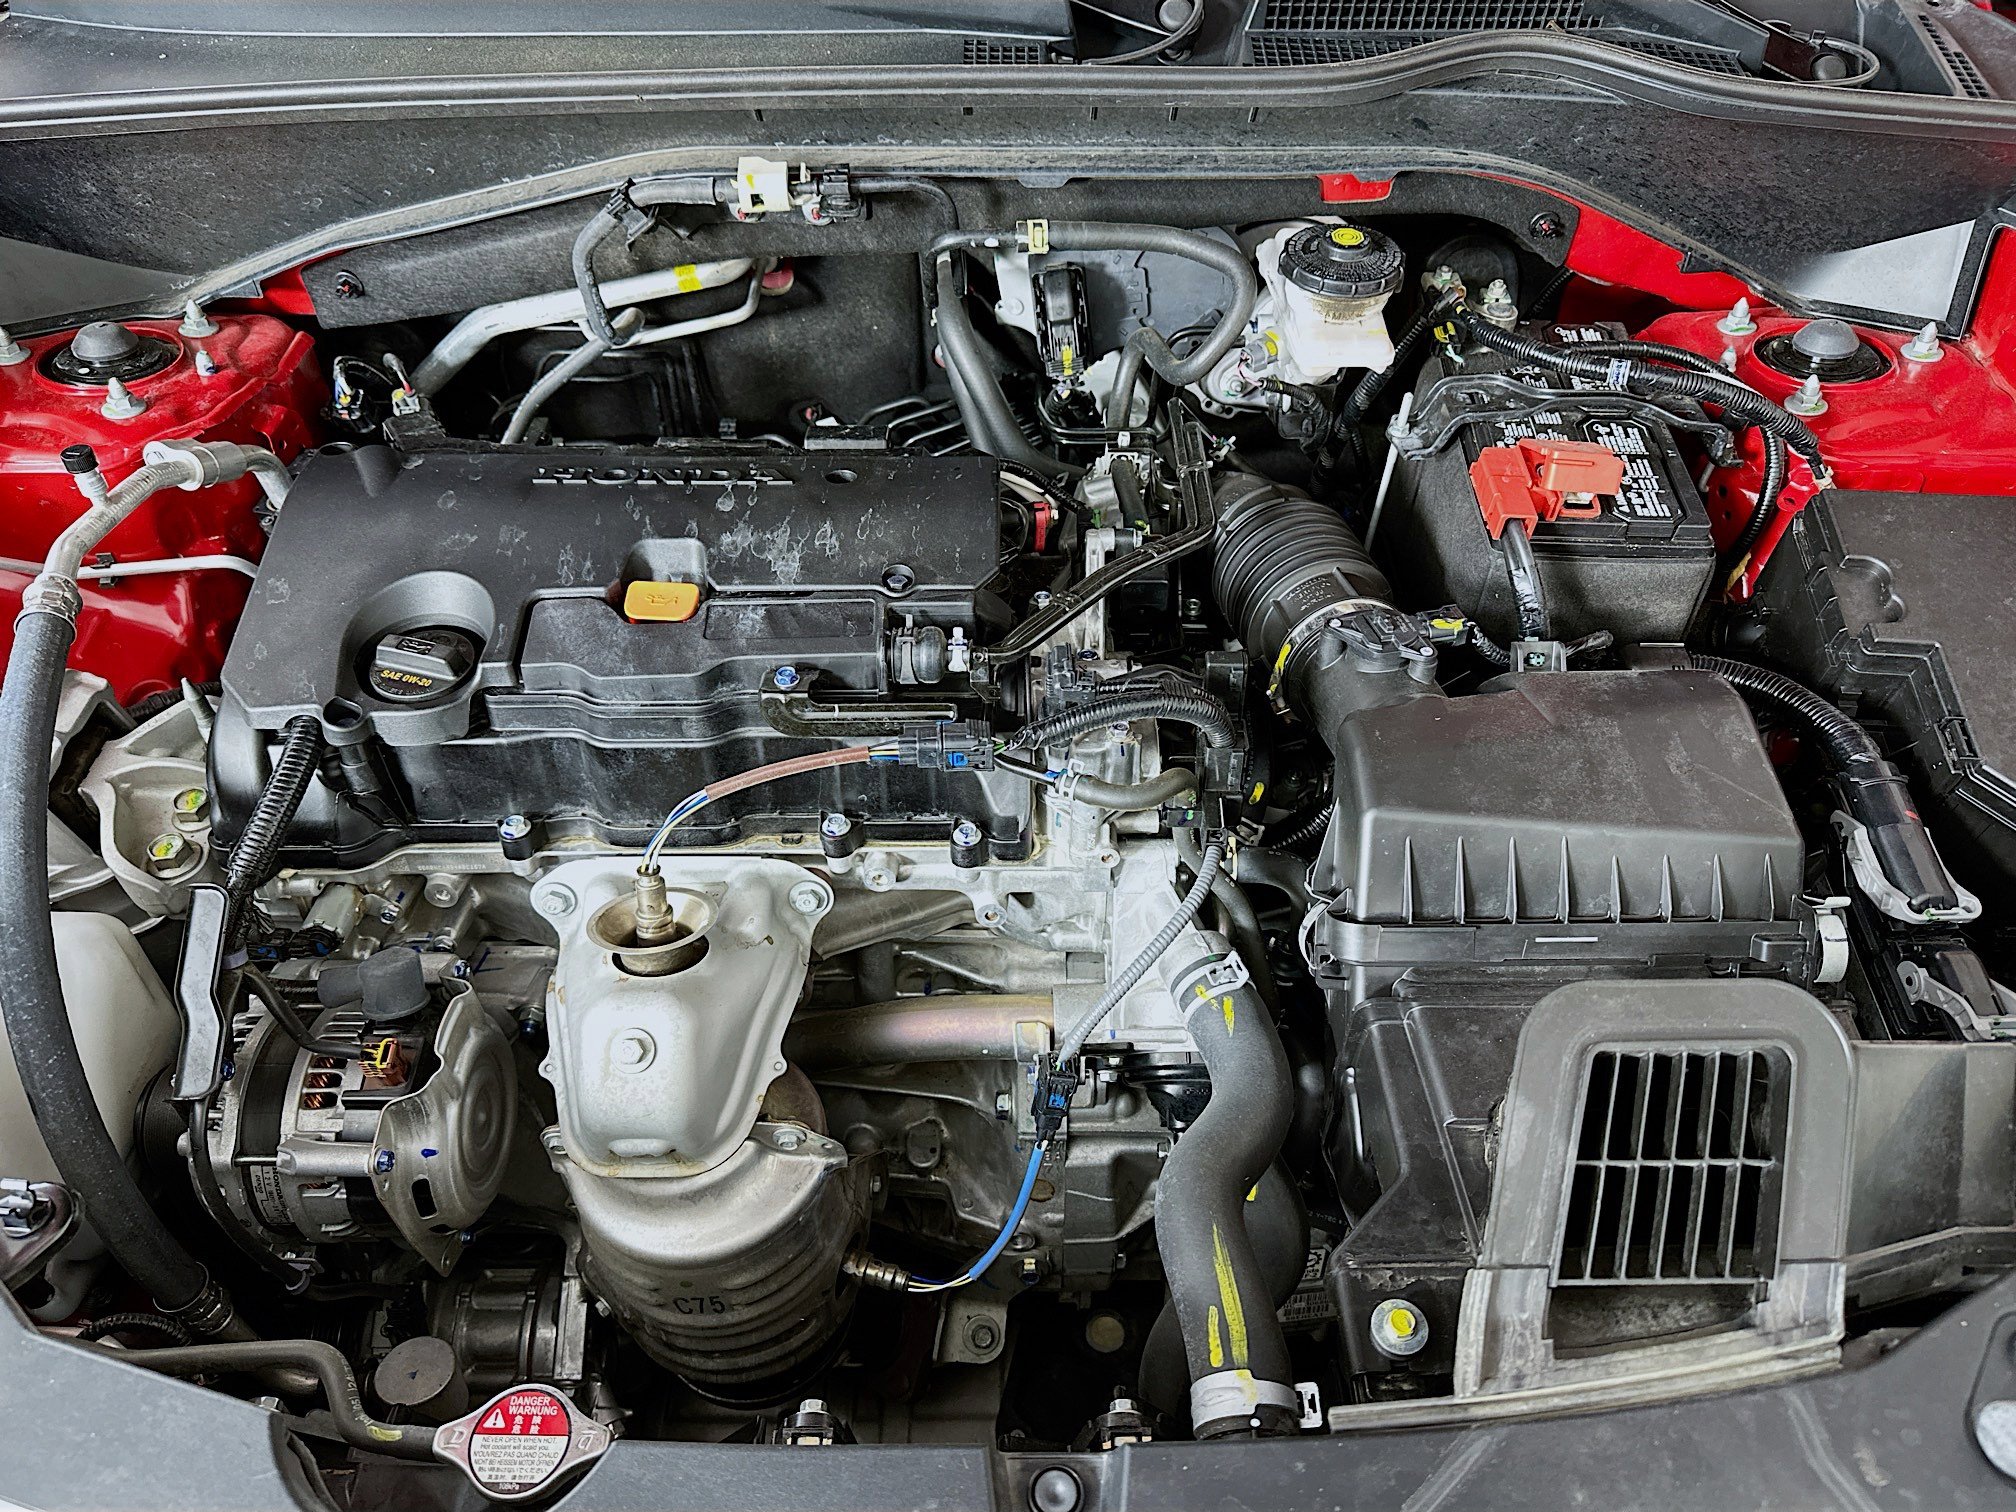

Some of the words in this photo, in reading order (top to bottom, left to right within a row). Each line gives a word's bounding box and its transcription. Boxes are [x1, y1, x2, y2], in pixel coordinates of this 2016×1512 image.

[531, 466, 794, 485] HONDA
[380, 669, 404, 680] SAE
[401, 674, 433, 687] 0W-20
[672, 1295, 726, 1315] C75
[510, 1395, 551, 1406] DANGER
[508, 1405, 559, 1415] WARNUNG
[499, 1483, 520, 1491] 108kPa
